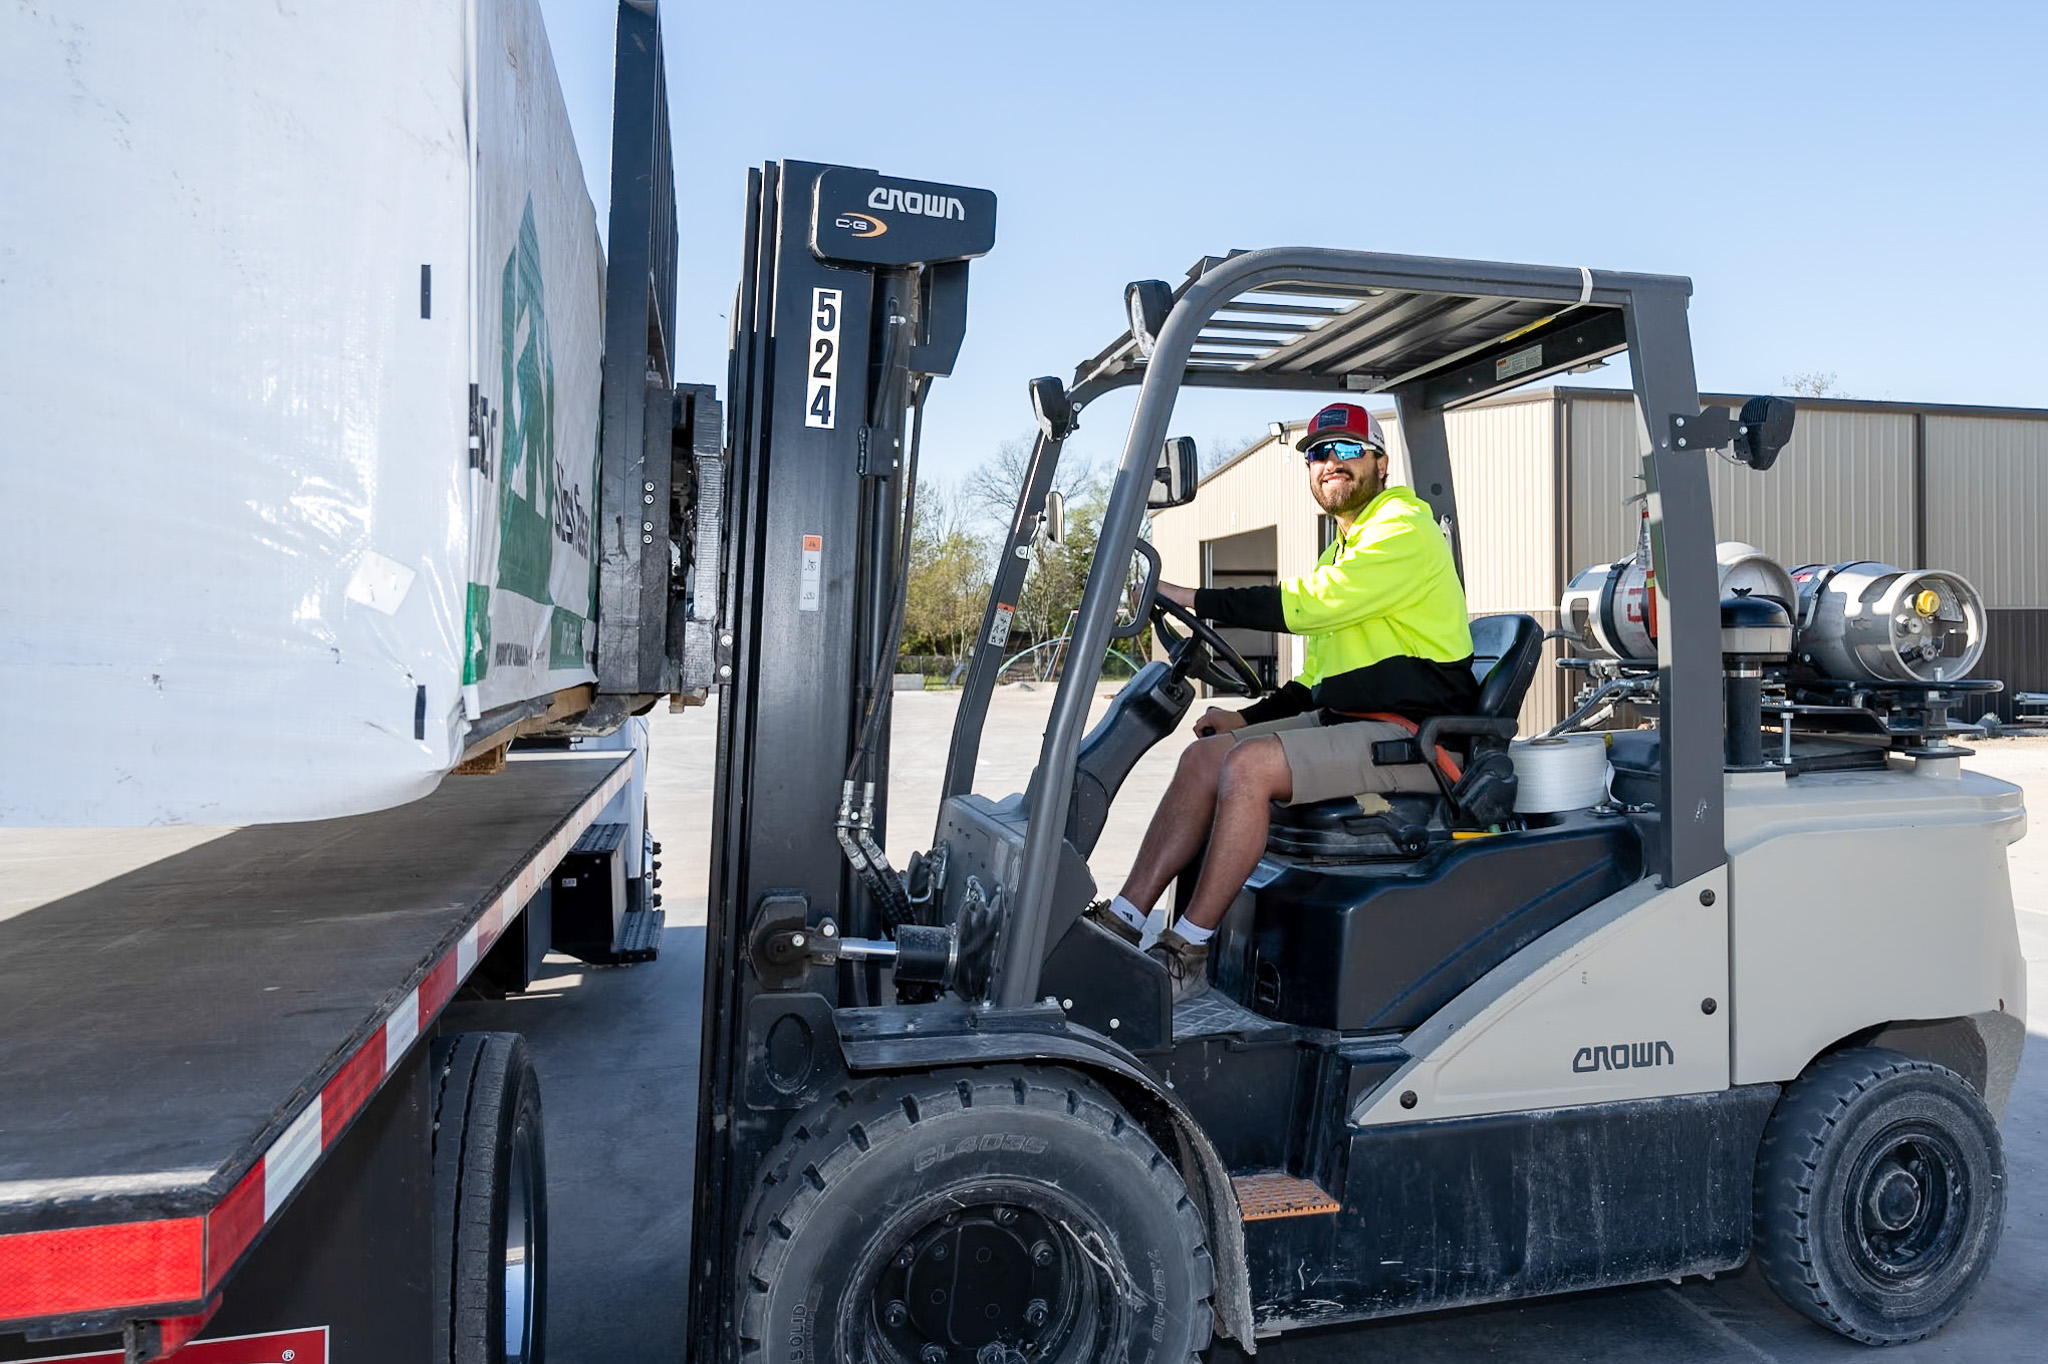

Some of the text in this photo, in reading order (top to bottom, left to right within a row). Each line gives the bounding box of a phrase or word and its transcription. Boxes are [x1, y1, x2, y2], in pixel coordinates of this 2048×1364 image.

[868, 187, 965, 221] CROWN
[810, 291, 837, 425] 524
[1572, 1040, 1674, 1073] CROWN
